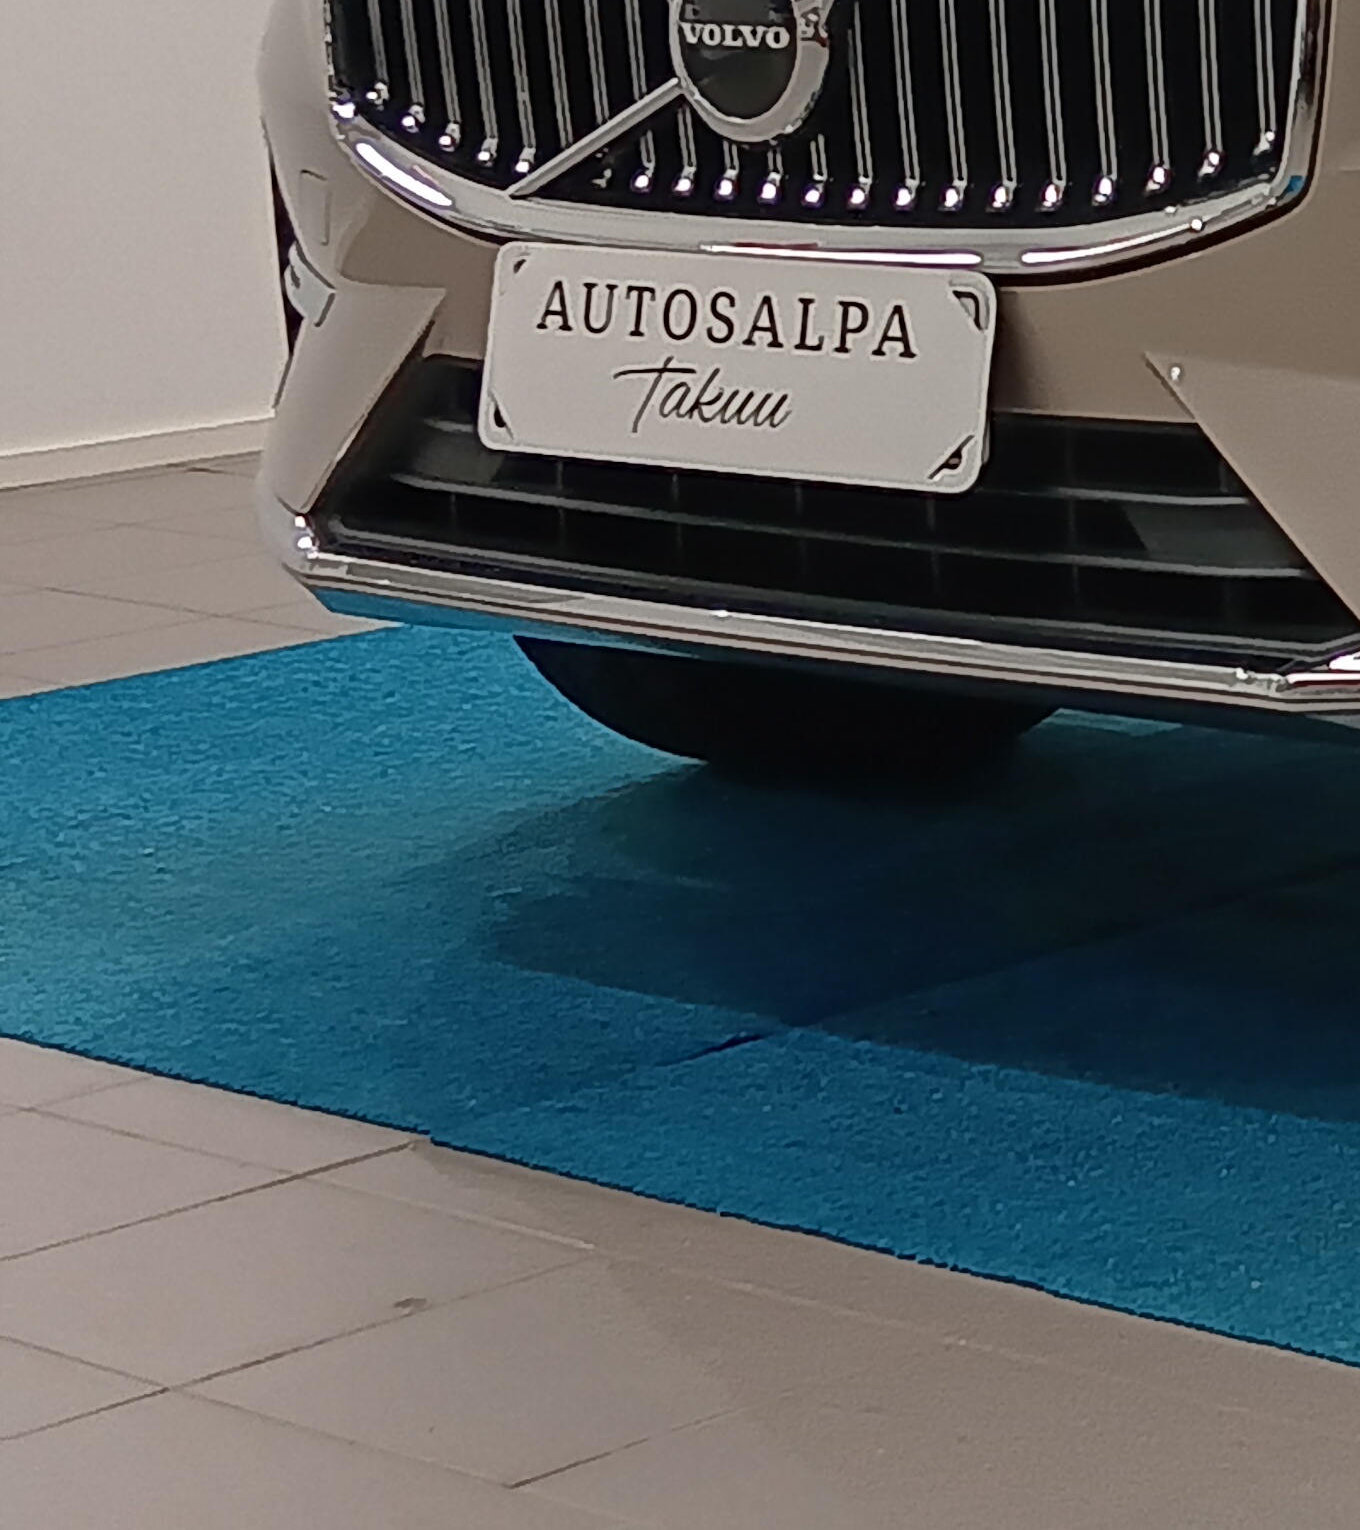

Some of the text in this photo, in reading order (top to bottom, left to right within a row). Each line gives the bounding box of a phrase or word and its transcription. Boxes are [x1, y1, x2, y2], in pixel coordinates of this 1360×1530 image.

[682, 22, 791, 49] VOLVO
[536, 280, 918, 359] AUTOSALPA
[612, 356, 793, 434] Takuu
